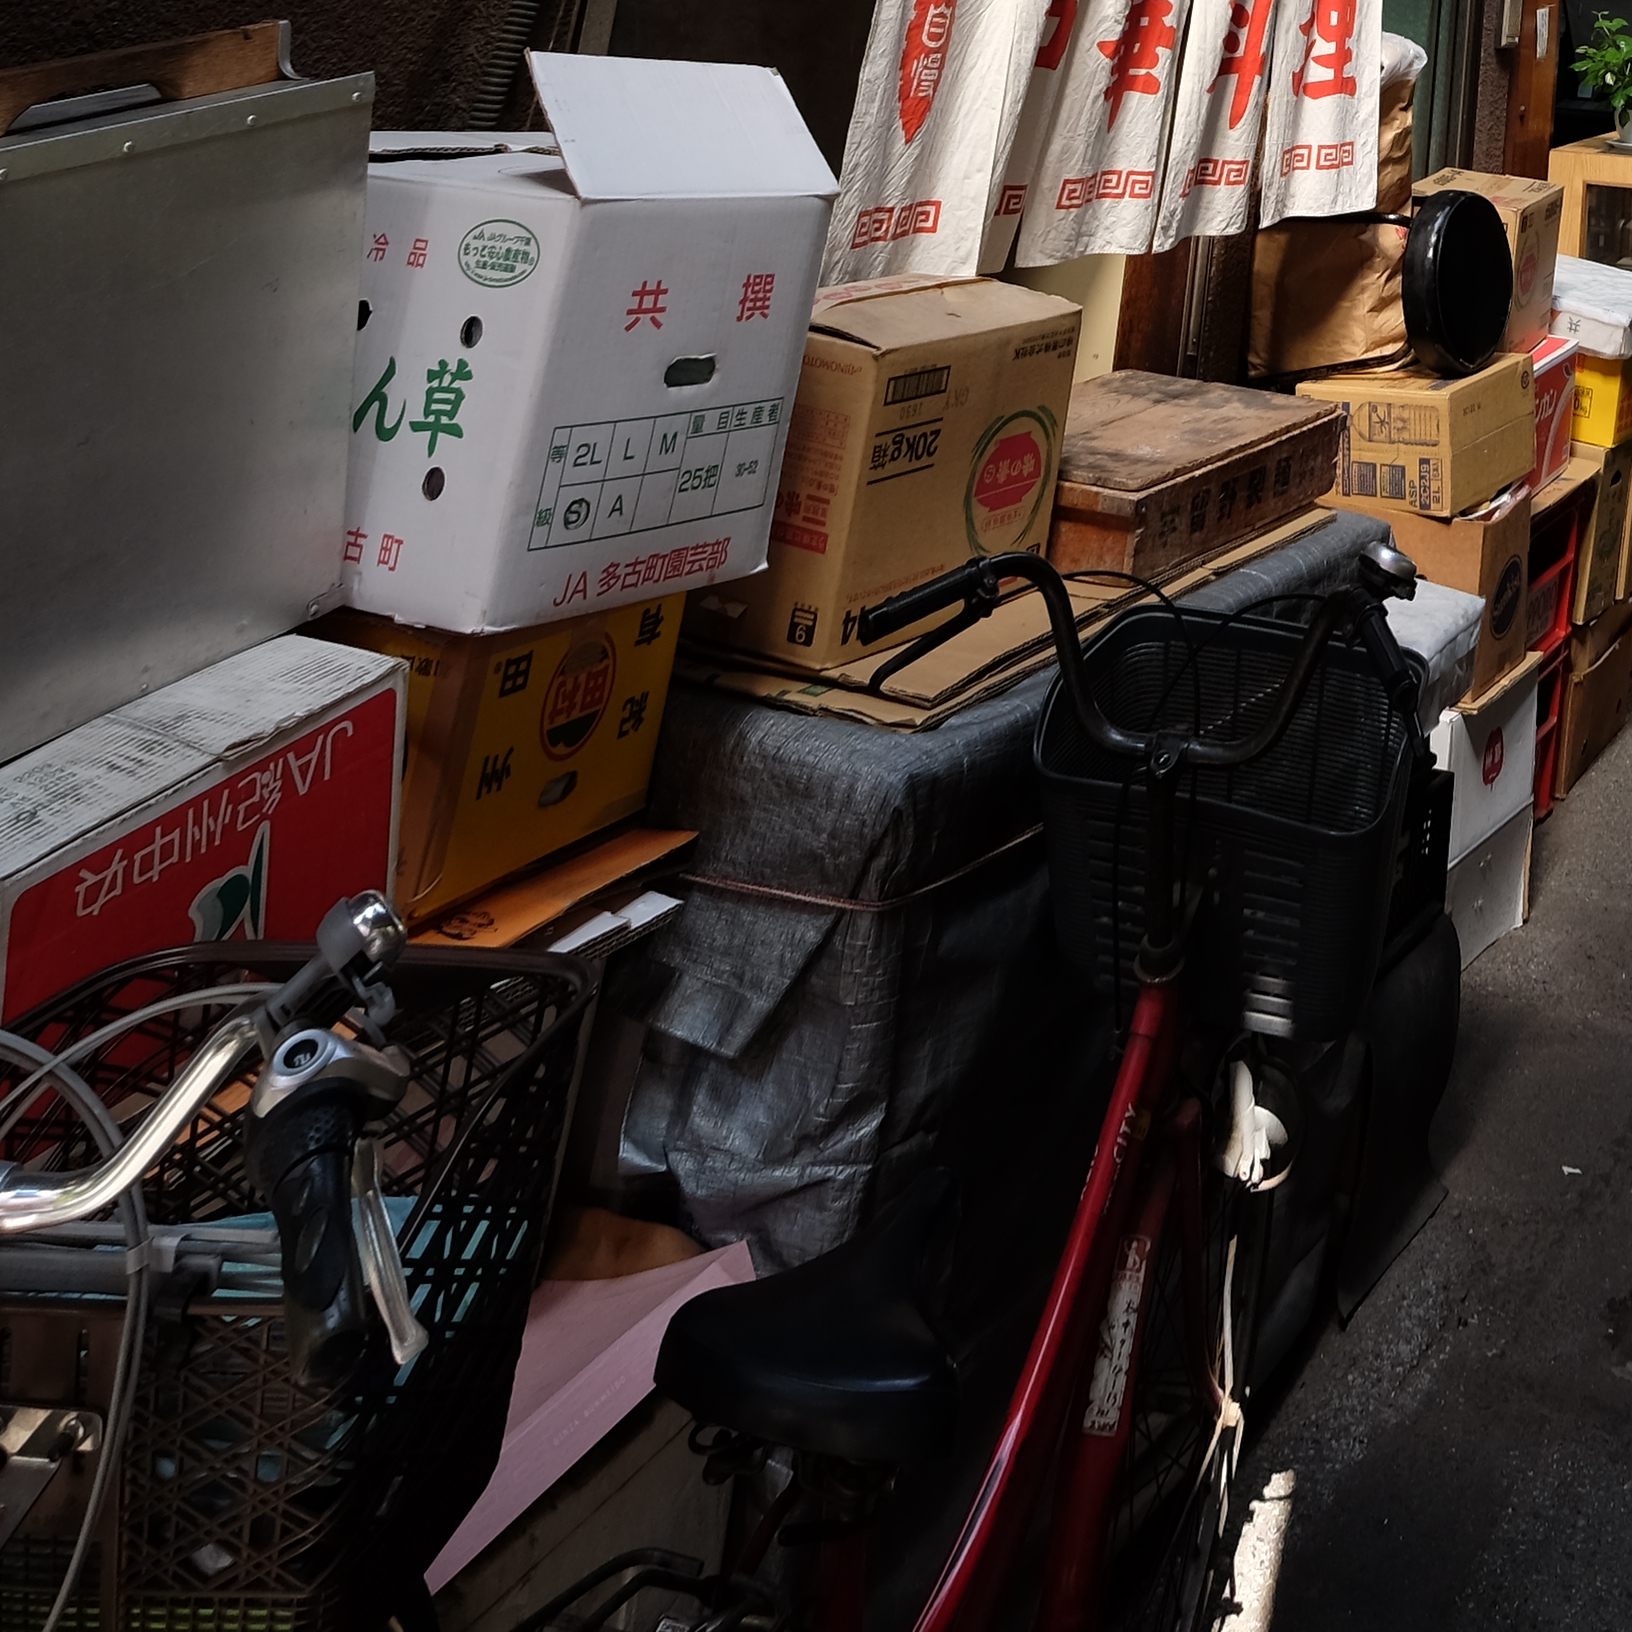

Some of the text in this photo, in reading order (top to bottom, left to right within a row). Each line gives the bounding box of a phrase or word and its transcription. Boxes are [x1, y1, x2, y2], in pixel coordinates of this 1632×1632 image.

[352, 355, 474, 458] ん草
[733, 402, 780, 429] 生産者
[572, 442, 603, 469] 2L
[622, 437, 636, 461] L
[658, 431, 679, 456] M
[869, 427, 942, 471] 20kg箱
[607, 494, 624, 518] A
[1407, 479, 1418, 508] ASP
[553, 570, 588, 608] JA
[75, 718, 355, 919] JA紀州中央
[1111, 1101, 1139, 1164] CITY
